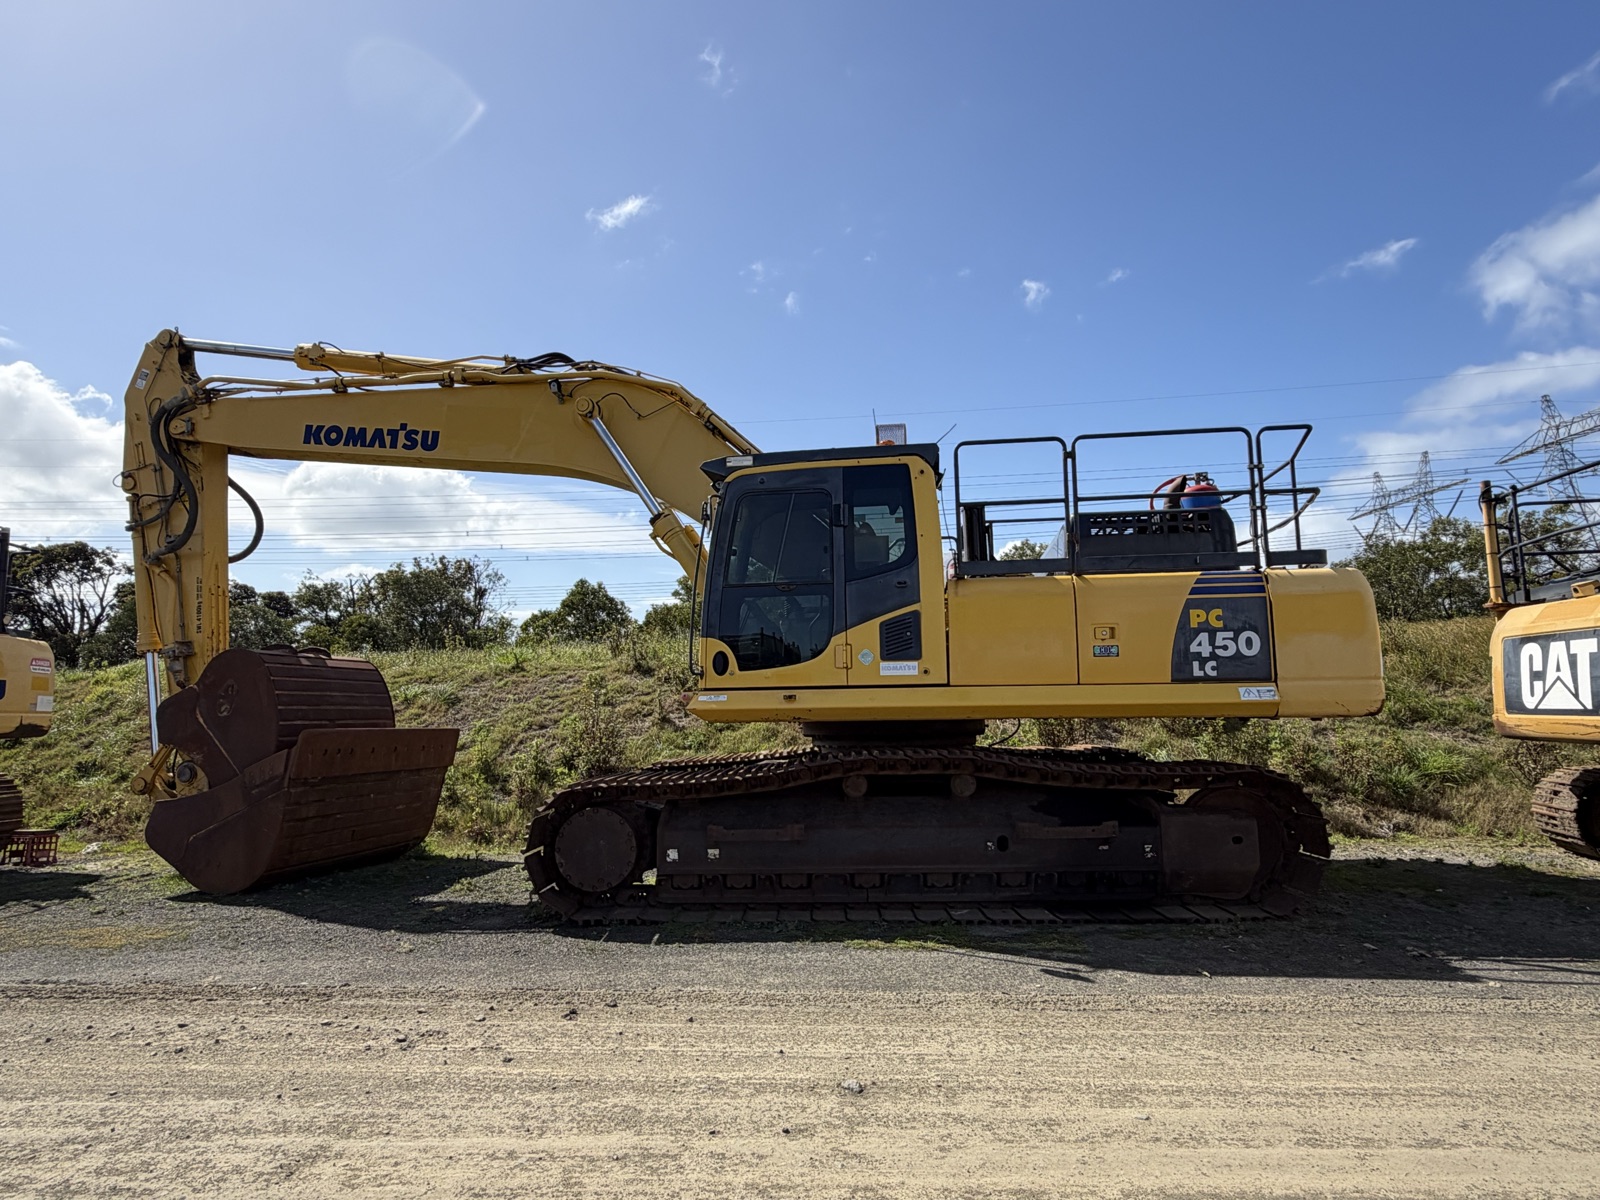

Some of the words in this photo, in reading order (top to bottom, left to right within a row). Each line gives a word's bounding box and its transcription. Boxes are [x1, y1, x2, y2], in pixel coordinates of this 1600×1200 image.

[303, 423, 439, 452] KOMATSU
[1189, 609, 1223, 628] PC
[1189, 631, 1261, 657] 450
[881, 663, 917, 672] KOMATSU
[1191, 660, 1218, 678] LC
[1519, 637, 1599, 710] CAT
